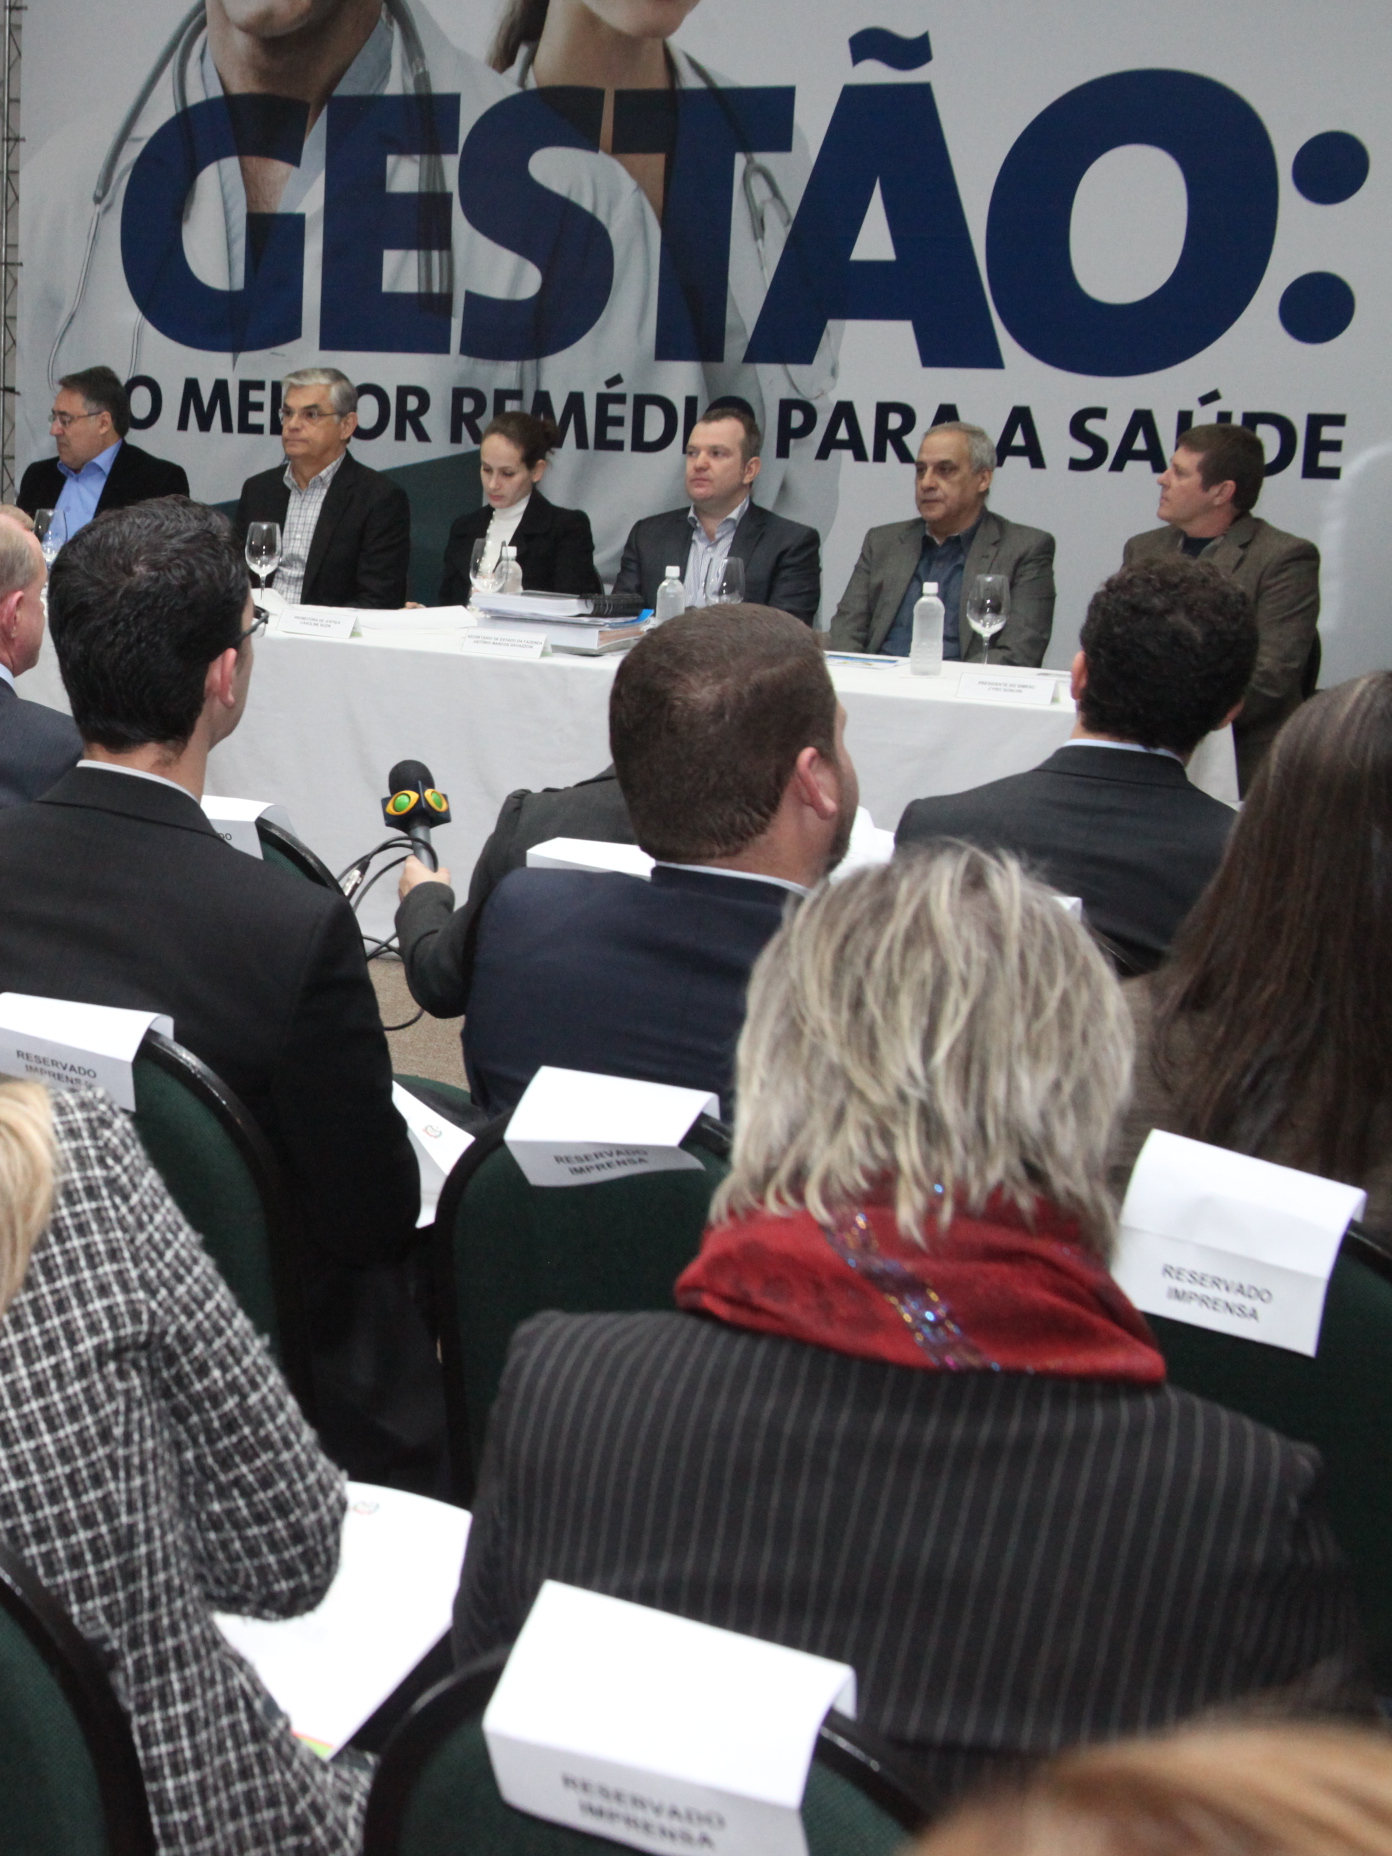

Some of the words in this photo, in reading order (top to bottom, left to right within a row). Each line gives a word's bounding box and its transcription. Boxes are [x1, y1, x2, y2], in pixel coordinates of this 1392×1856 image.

[120, 25, 1370, 377] GESTÃO:
[124, 375, 162, 430] O
[177, 377, 432, 443] MELOR
[996, 405, 1047, 469] A
[16, 1049, 97, 1079] RESERVADO
[554, 1149, 648, 1164] RESERVADO
[569, 1157, 648, 1175] IMPRENSA
[1162, 1263, 1273, 1304] RESERVADO
[1167, 1285, 1259, 1322] IMPRENSA
[561, 1773, 726, 1831] RESERVADO
[578, 1799, 715, 1850] IMPRENSA
